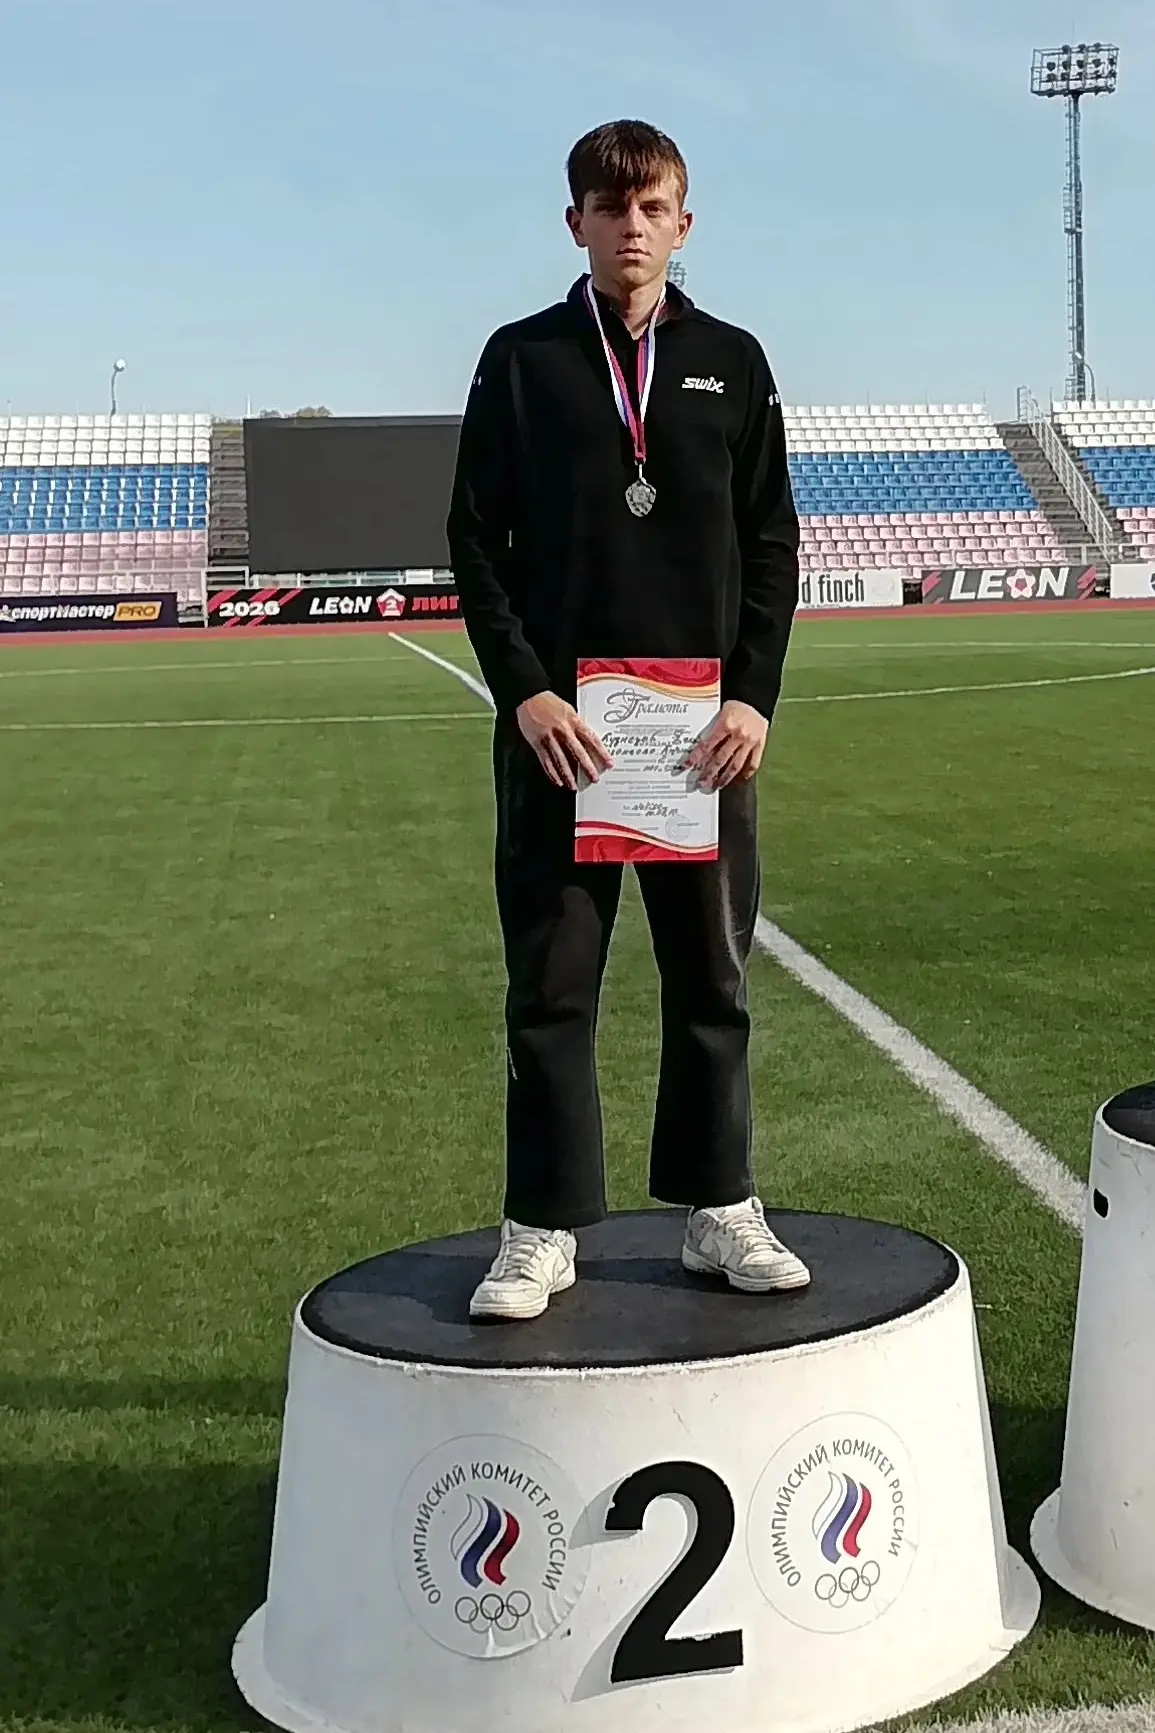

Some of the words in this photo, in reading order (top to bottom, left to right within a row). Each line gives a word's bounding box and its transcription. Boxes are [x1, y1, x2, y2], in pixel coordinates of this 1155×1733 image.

[681, 376, 725, 394] swix
[817, 571, 865, 603] finch
[950, 567, 1070, 600] LEON
[116, 604, 157, 617] PRO
[219, 600, 281, 618] 2026
[309, 596, 372, 616] LEON
[771, 1443, 830, 1588] ОЛИМПИЙСКИЙ
[832, 1438, 896, 1478] КОМИТЕТ
[887, 1478, 906, 1557] РОССИИ
[412, 1464, 467, 1605] ОЛИМПИЙСКИЙ
[470, 1461, 552, 1508] КОМИТЕТ
[541, 1508, 567, 1591] РОССИИ
[604, 1460, 744, 1684] 2
